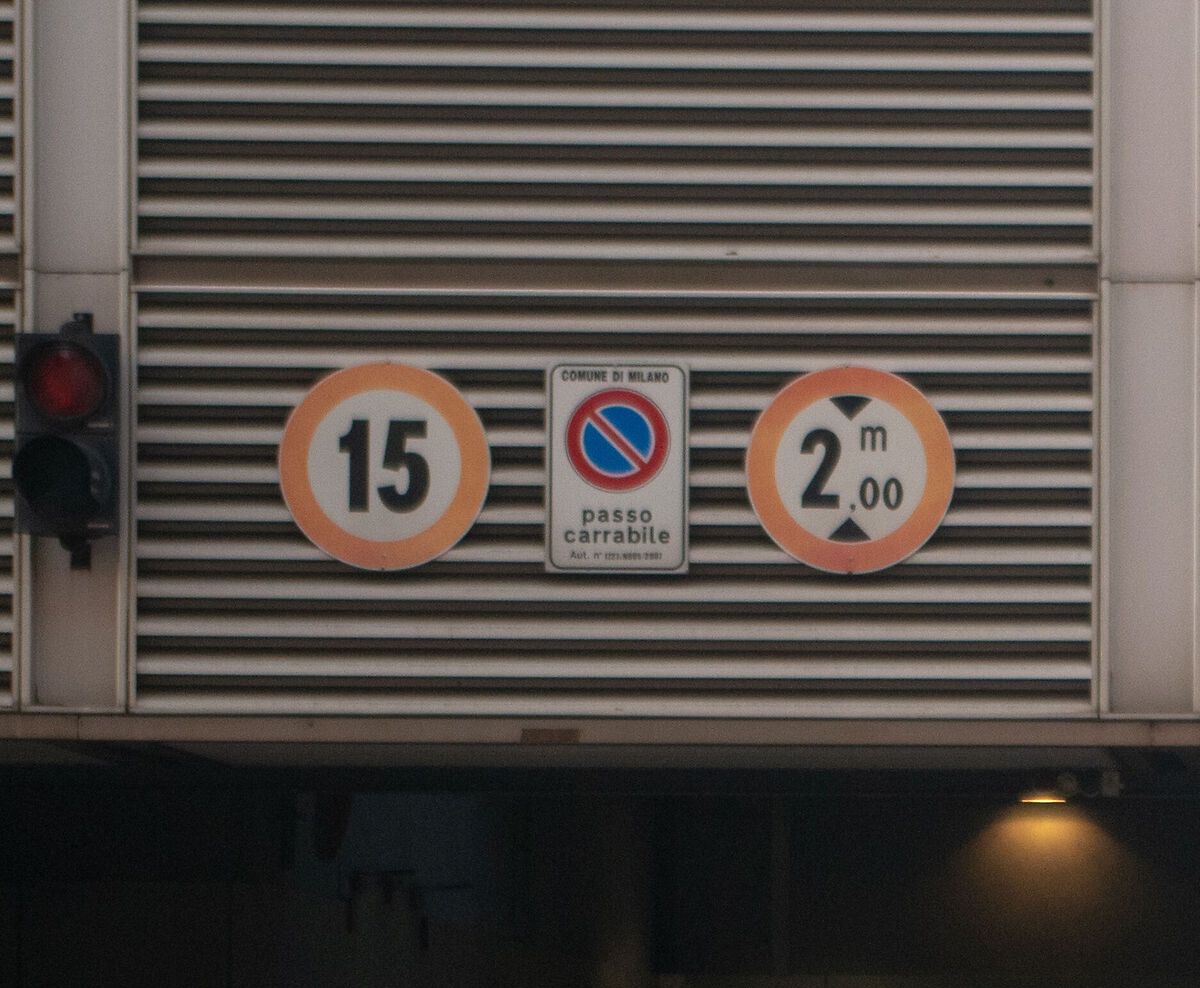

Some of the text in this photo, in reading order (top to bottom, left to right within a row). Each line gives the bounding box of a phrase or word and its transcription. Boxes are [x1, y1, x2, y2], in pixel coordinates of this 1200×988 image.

[561, 369, 670, 383] COMUNE DI MILANO
[860, 424, 887, 452] m
[338, 418, 429, 514] 15
[582, 508, 653, 525] passo
[564, 526, 671, 544] carrabile
[570, 550, 590, 560] Aut.
